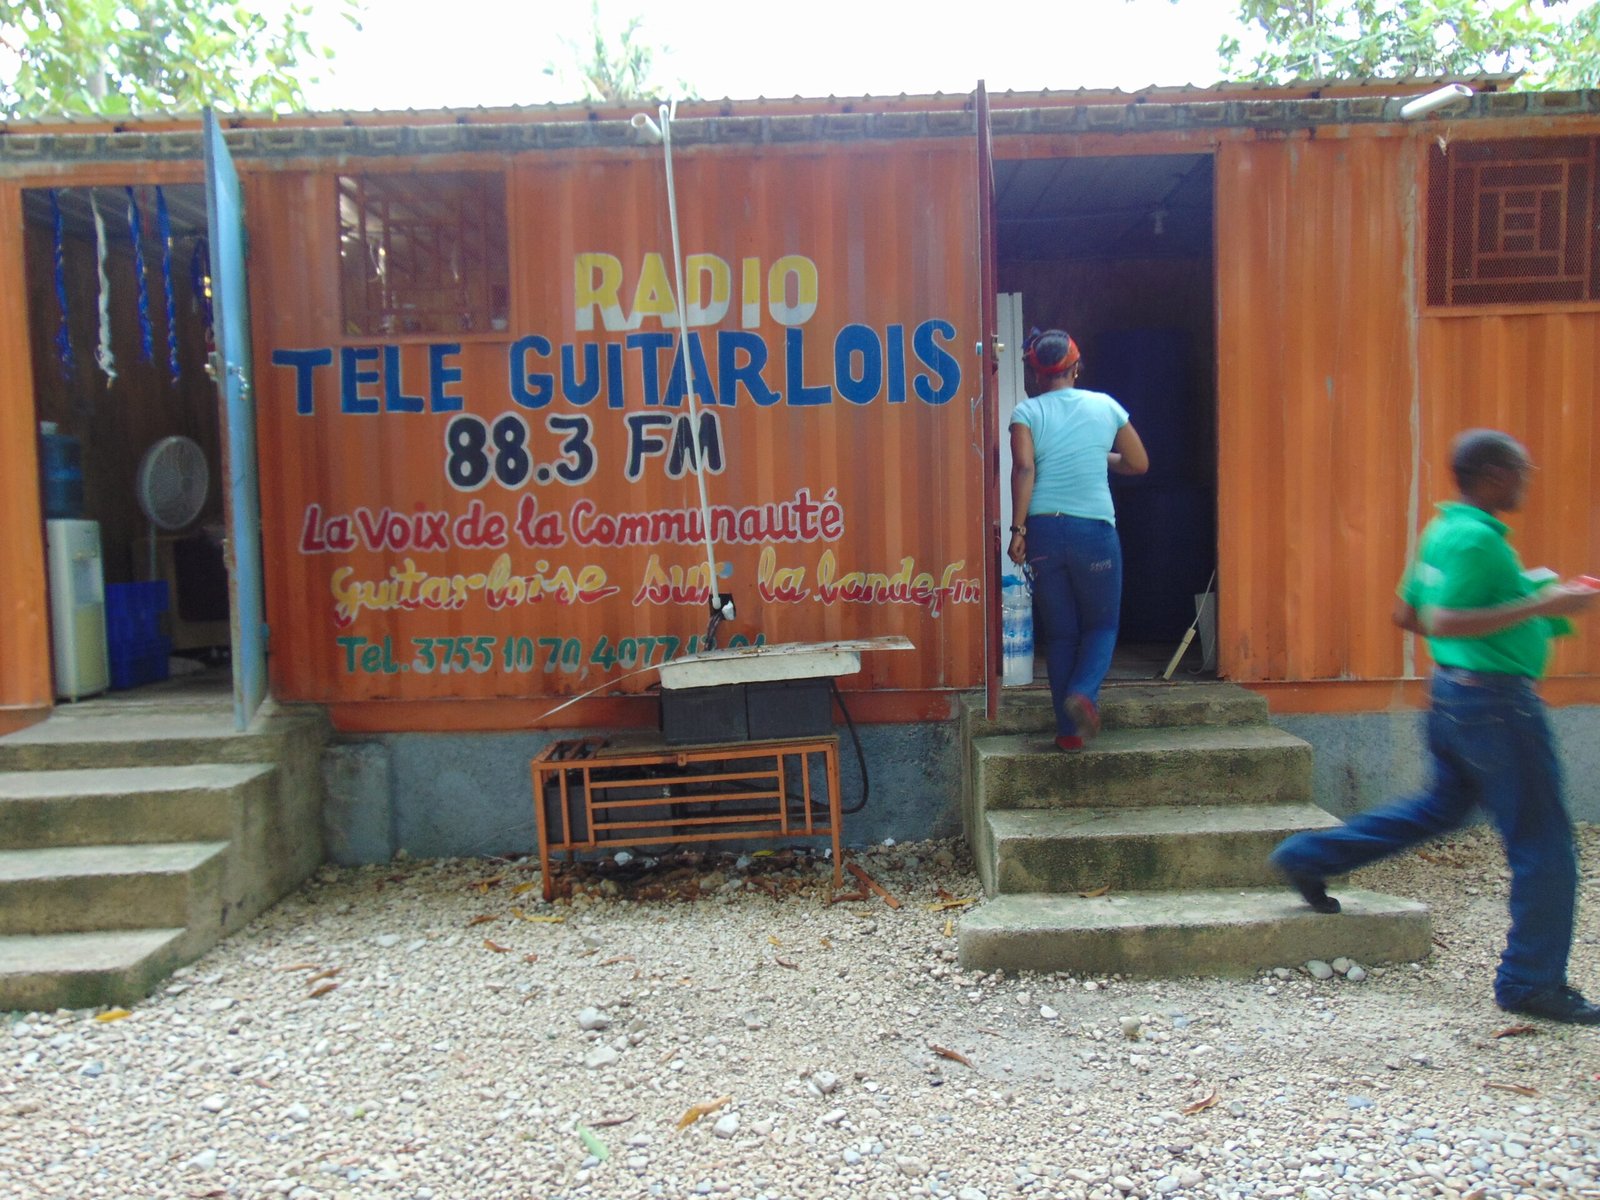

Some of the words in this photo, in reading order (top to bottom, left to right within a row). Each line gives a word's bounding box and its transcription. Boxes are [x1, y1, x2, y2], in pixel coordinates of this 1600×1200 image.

[574, 252, 819, 332] RADIO
[272, 343, 464, 416] TELE
[509, 318, 962, 410] GUITARLOIS
[444, 412, 597, 492] 88.3
[623, 407, 726, 483] FM
[302, 504, 356, 555] La
[355, 506, 449, 551] Voix
[453, 499, 508, 549] de
[513, 493, 566, 548] la
[570, 487, 844, 549] Communauté
[632, 553, 734, 606] sur
[758, 546, 811, 604] la
[335, 635, 410, 674] Tel.
[411, 636, 497, 675] 3755
[503, 635, 534, 673] 10
[590, 634, 680, 673] 4077
